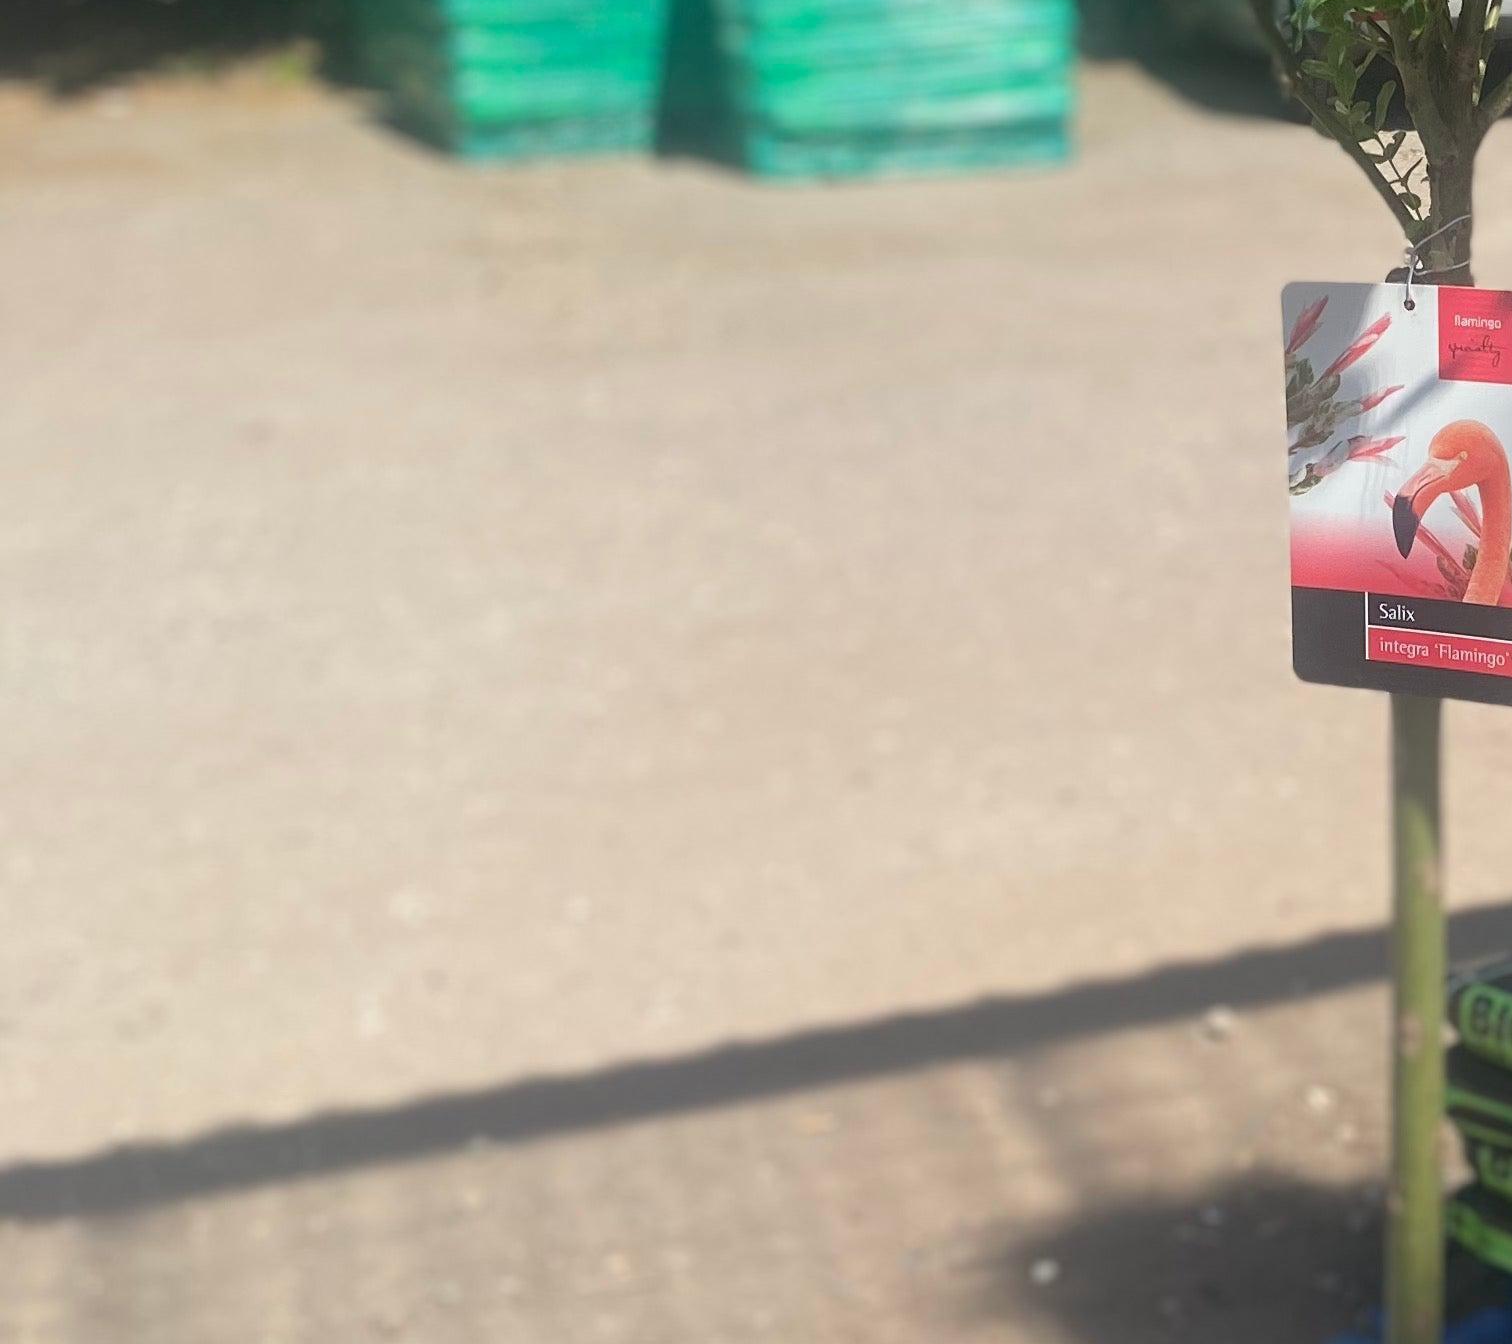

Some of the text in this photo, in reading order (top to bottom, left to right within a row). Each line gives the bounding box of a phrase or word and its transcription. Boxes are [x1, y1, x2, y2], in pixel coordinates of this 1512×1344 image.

[1454, 314, 1502, 330] flamingo
[1379, 603, 1415, 622] Salix
[1379, 636, 1429, 658] integra
